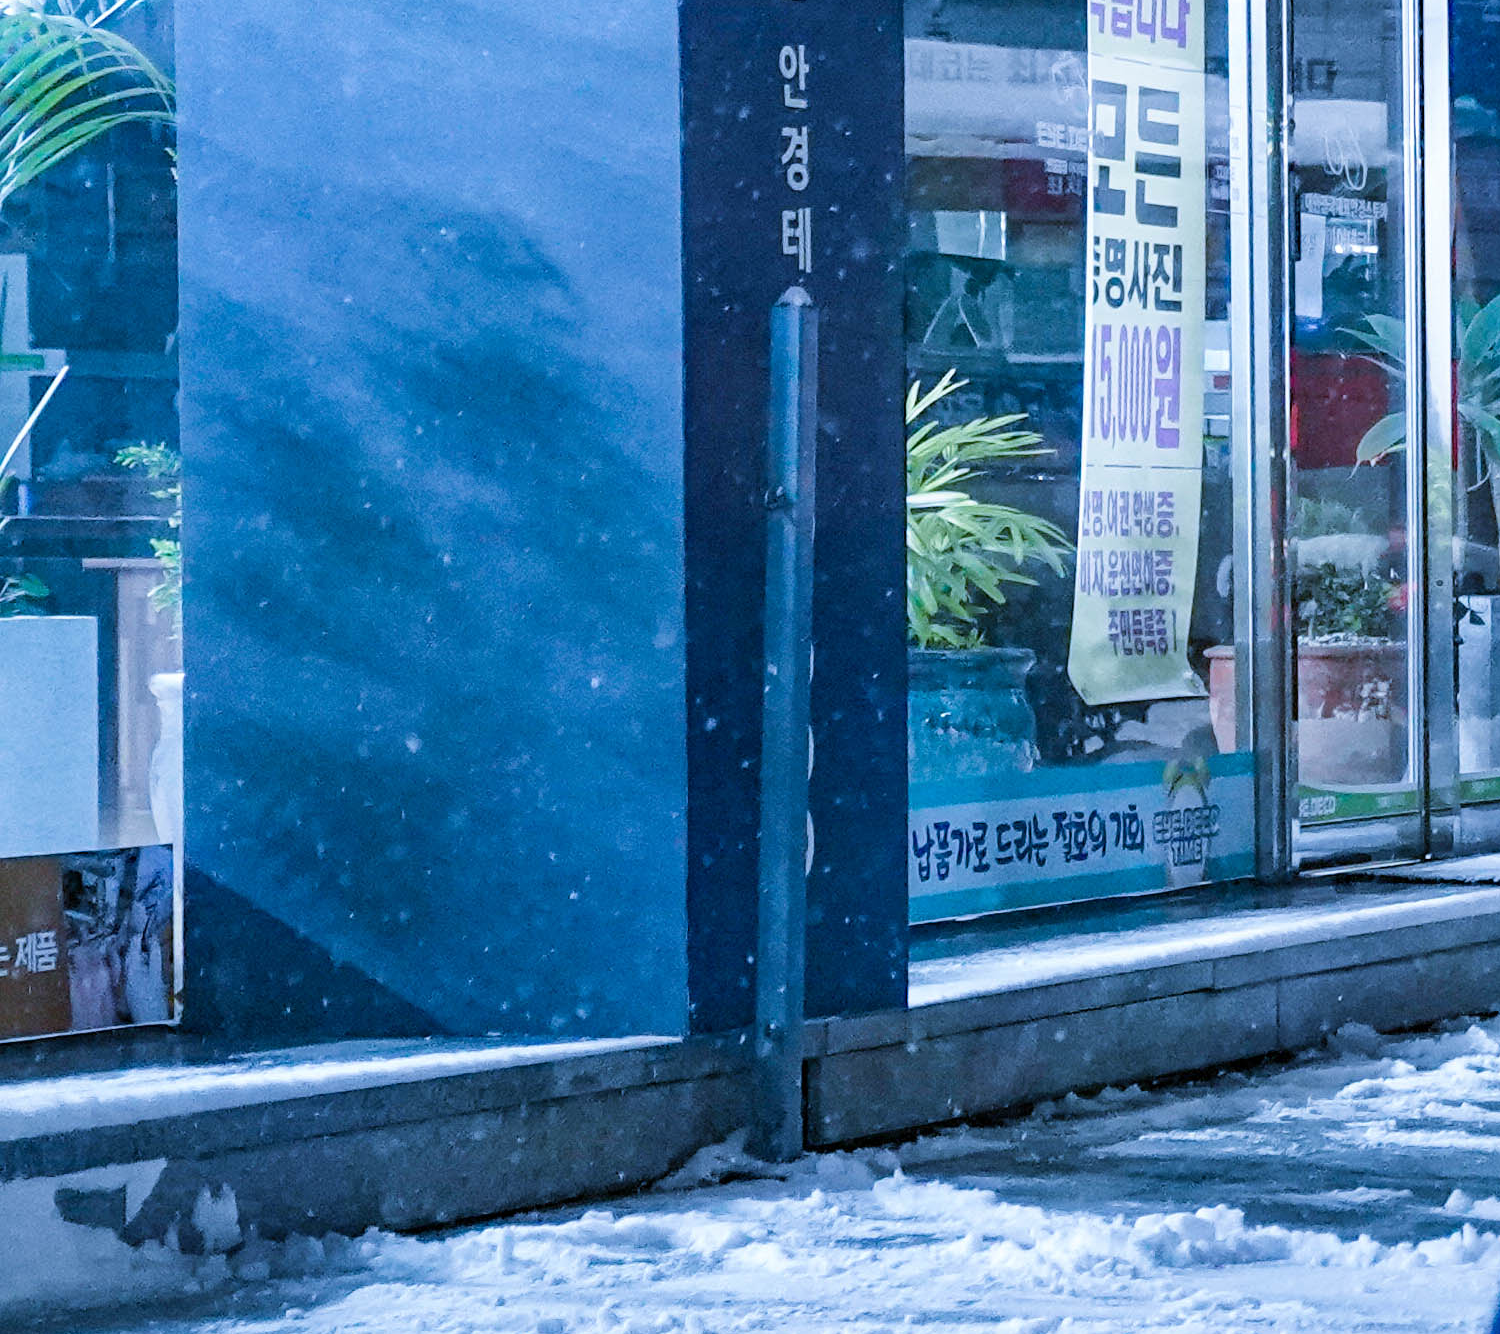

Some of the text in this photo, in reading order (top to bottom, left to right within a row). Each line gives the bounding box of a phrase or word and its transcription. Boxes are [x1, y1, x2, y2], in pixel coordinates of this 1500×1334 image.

[778, 43, 813, 275] 안경테
[1092, 79, 1181, 228] 모든
[995, 814, 1049, 867] 드리는
[1052, 810, 1107, 864] 절호의
[1109, 804, 1145, 854] 기회
[14, 930, 58, 974] 제품
